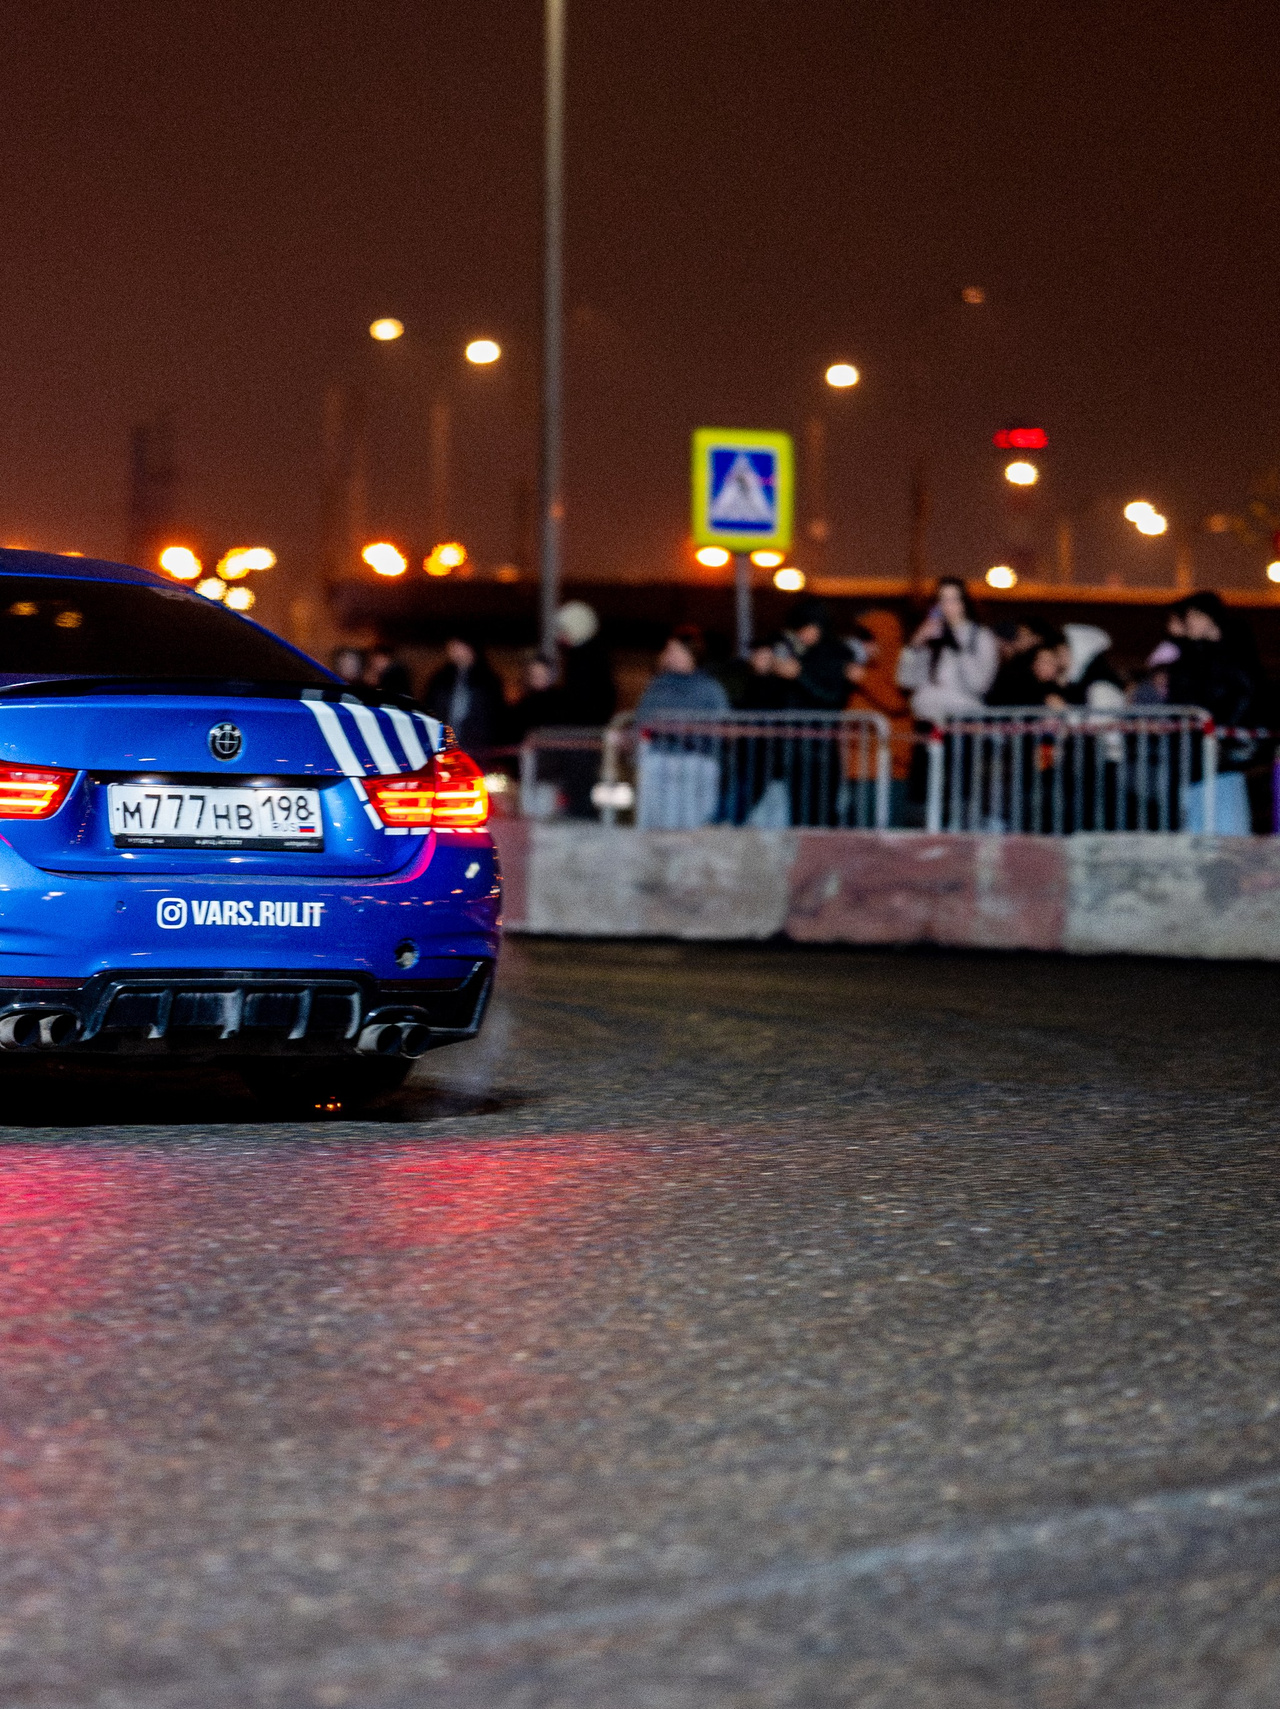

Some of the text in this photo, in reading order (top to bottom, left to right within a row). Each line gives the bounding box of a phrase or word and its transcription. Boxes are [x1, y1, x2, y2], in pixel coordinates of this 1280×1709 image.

[261, 795, 310, 821] 198
[272, 822, 298, 833] RUS
[191, 900, 325, 927] VARS.RULIT
